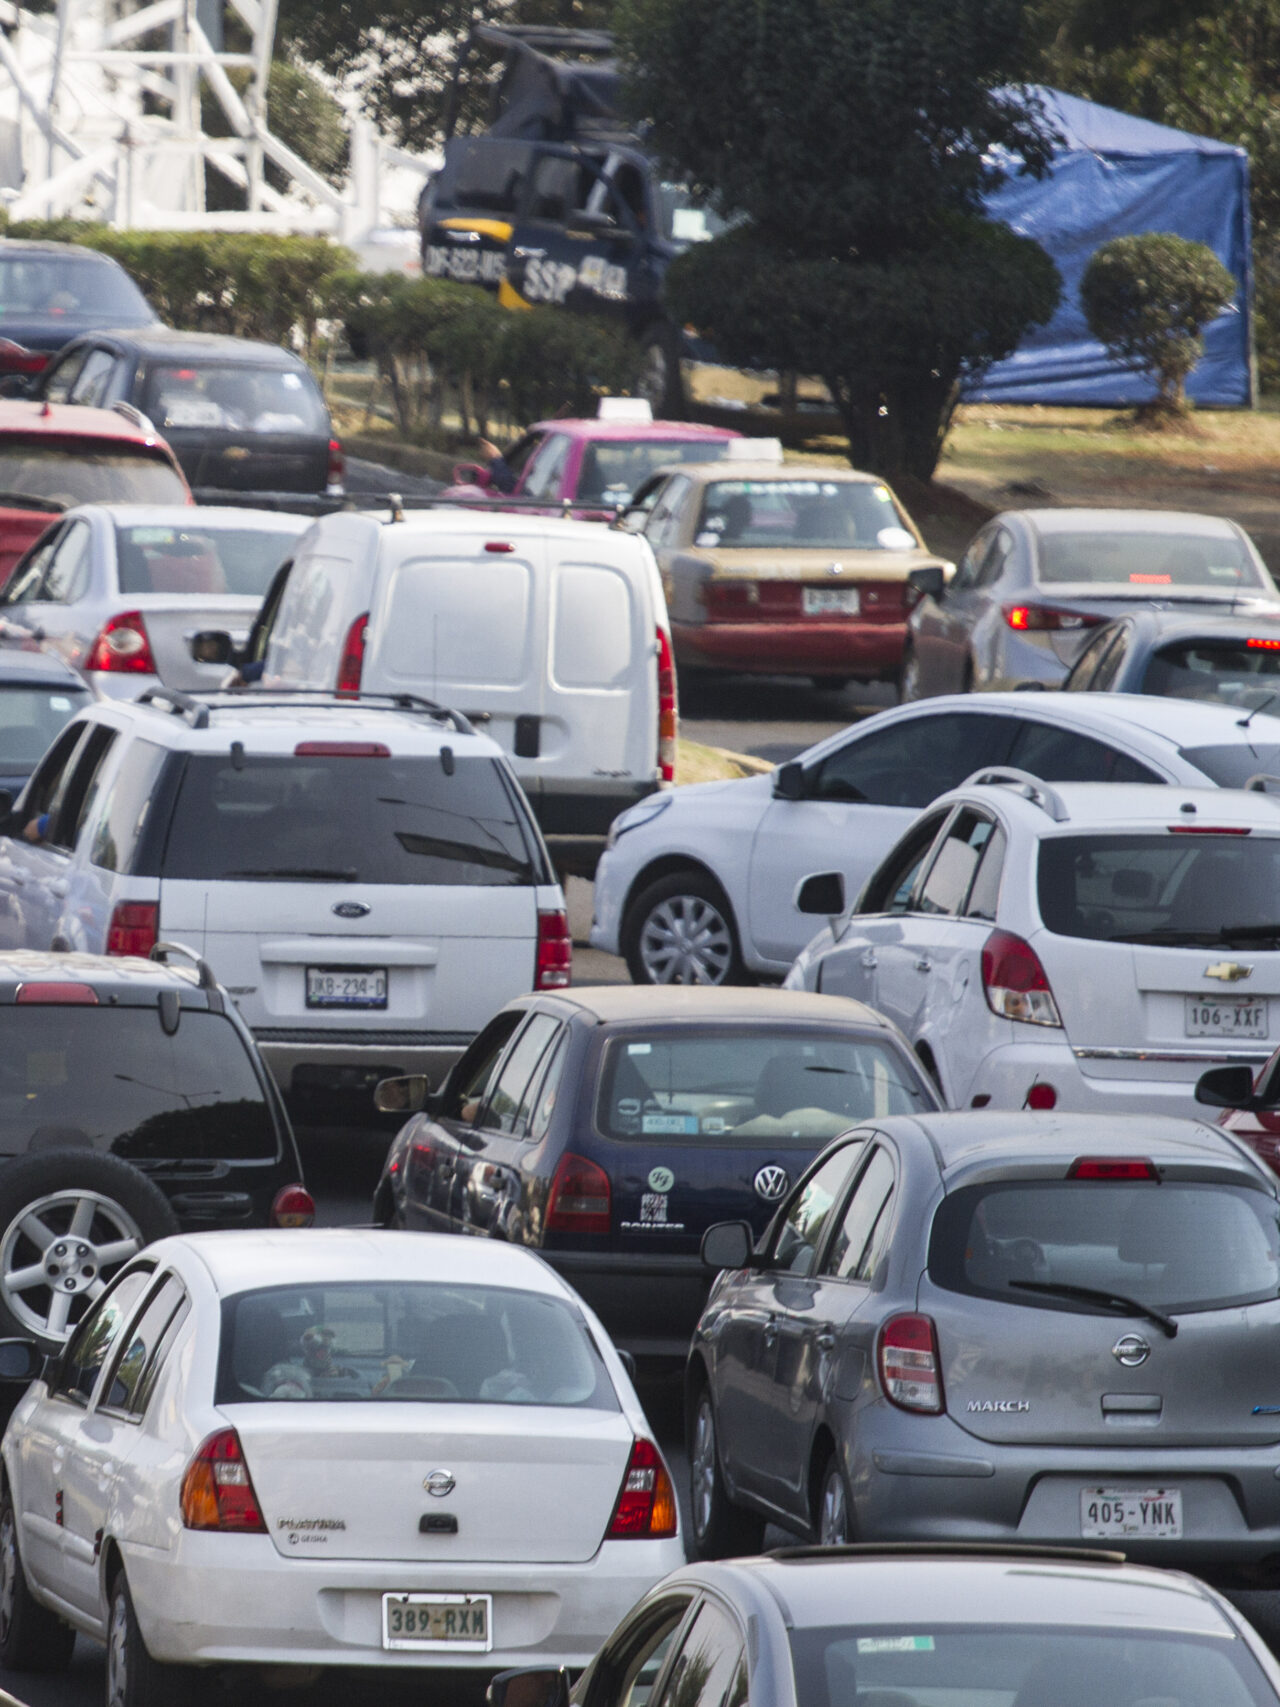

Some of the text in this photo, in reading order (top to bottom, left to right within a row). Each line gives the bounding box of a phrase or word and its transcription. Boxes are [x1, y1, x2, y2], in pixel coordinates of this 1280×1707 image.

[523, 257, 578, 304] SSP
[1192, 1007, 1263, 1027] 106-XXF
[967, 1401, 1030, 1412] MARCH
[1088, 1502, 1175, 1525] 405-YNK
[391, 1609, 484, 1634] 389-RXM
